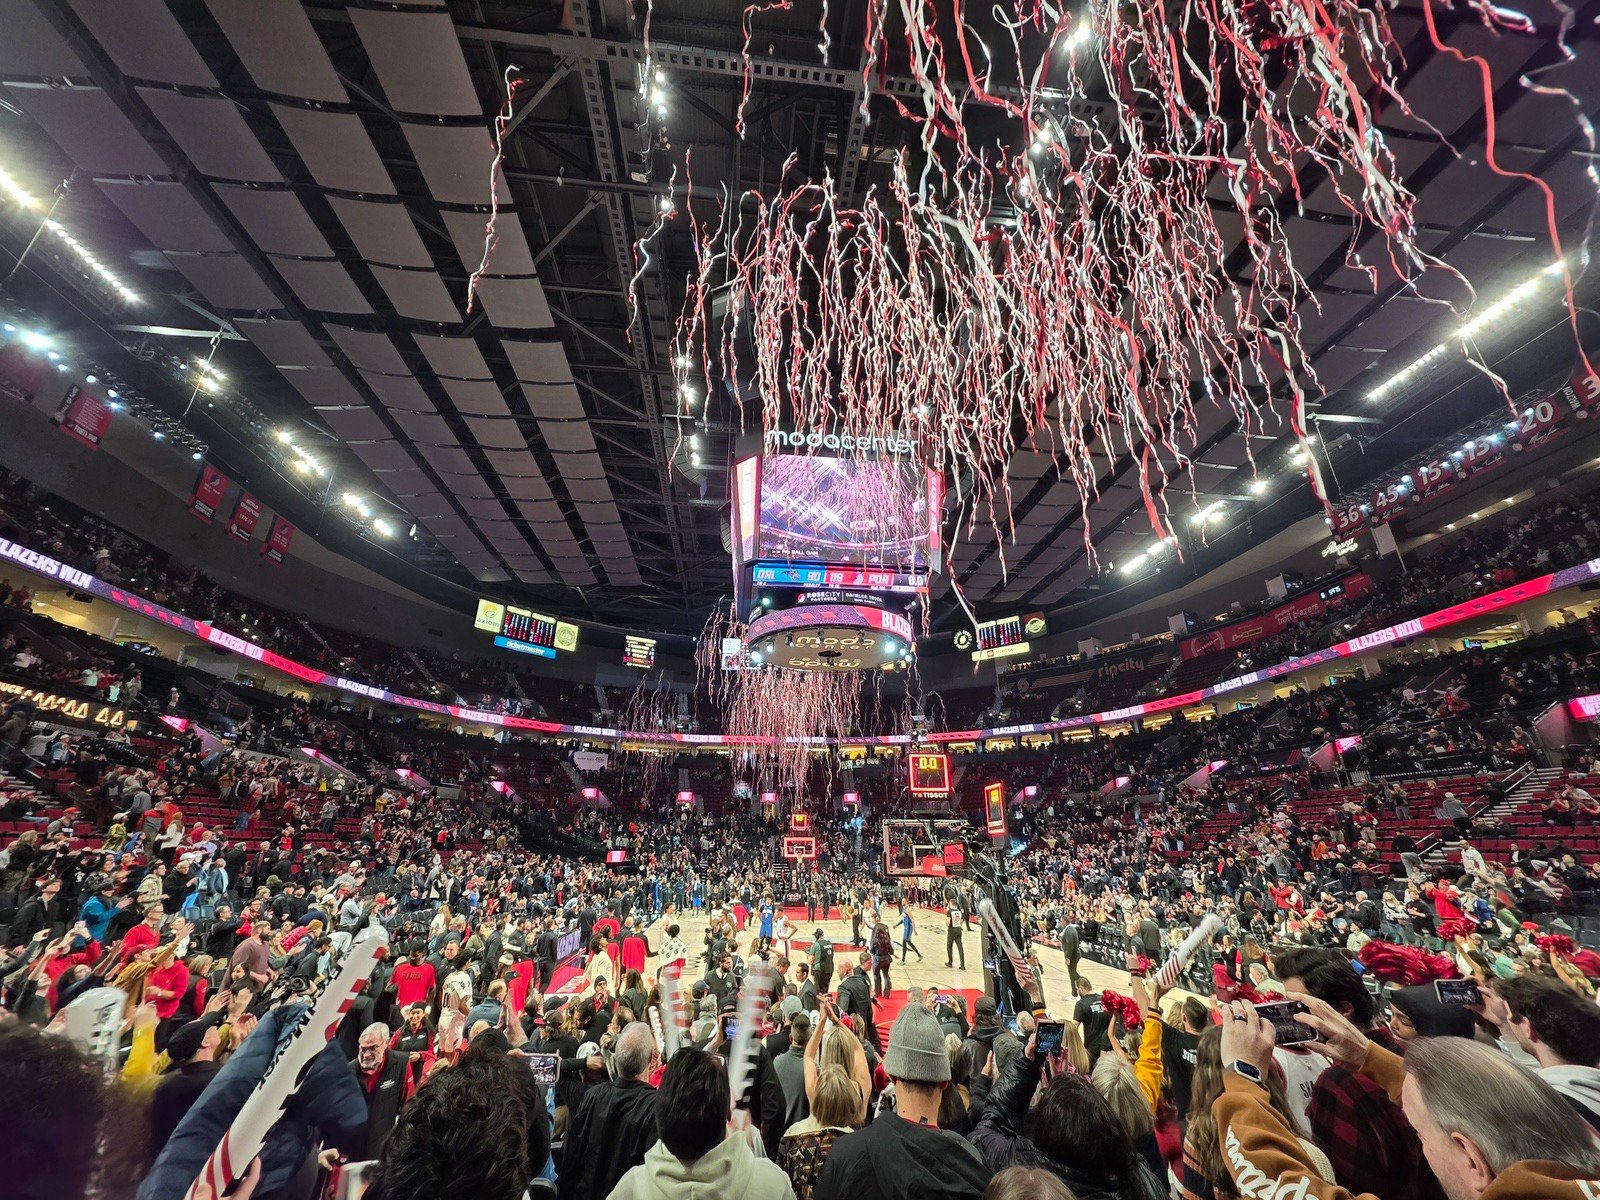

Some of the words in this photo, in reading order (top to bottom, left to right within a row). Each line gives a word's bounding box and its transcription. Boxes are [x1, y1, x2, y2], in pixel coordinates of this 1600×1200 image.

[1518, 401, 1554, 434] 20
[1418, 460, 1442, 485] 15
[1376, 484, 1401, 508] 45
[0, 536, 62, 575] LAZERS
[1349, 626, 1397, 650] BLAZERS
[1396, 618, 1423, 638] WIN
